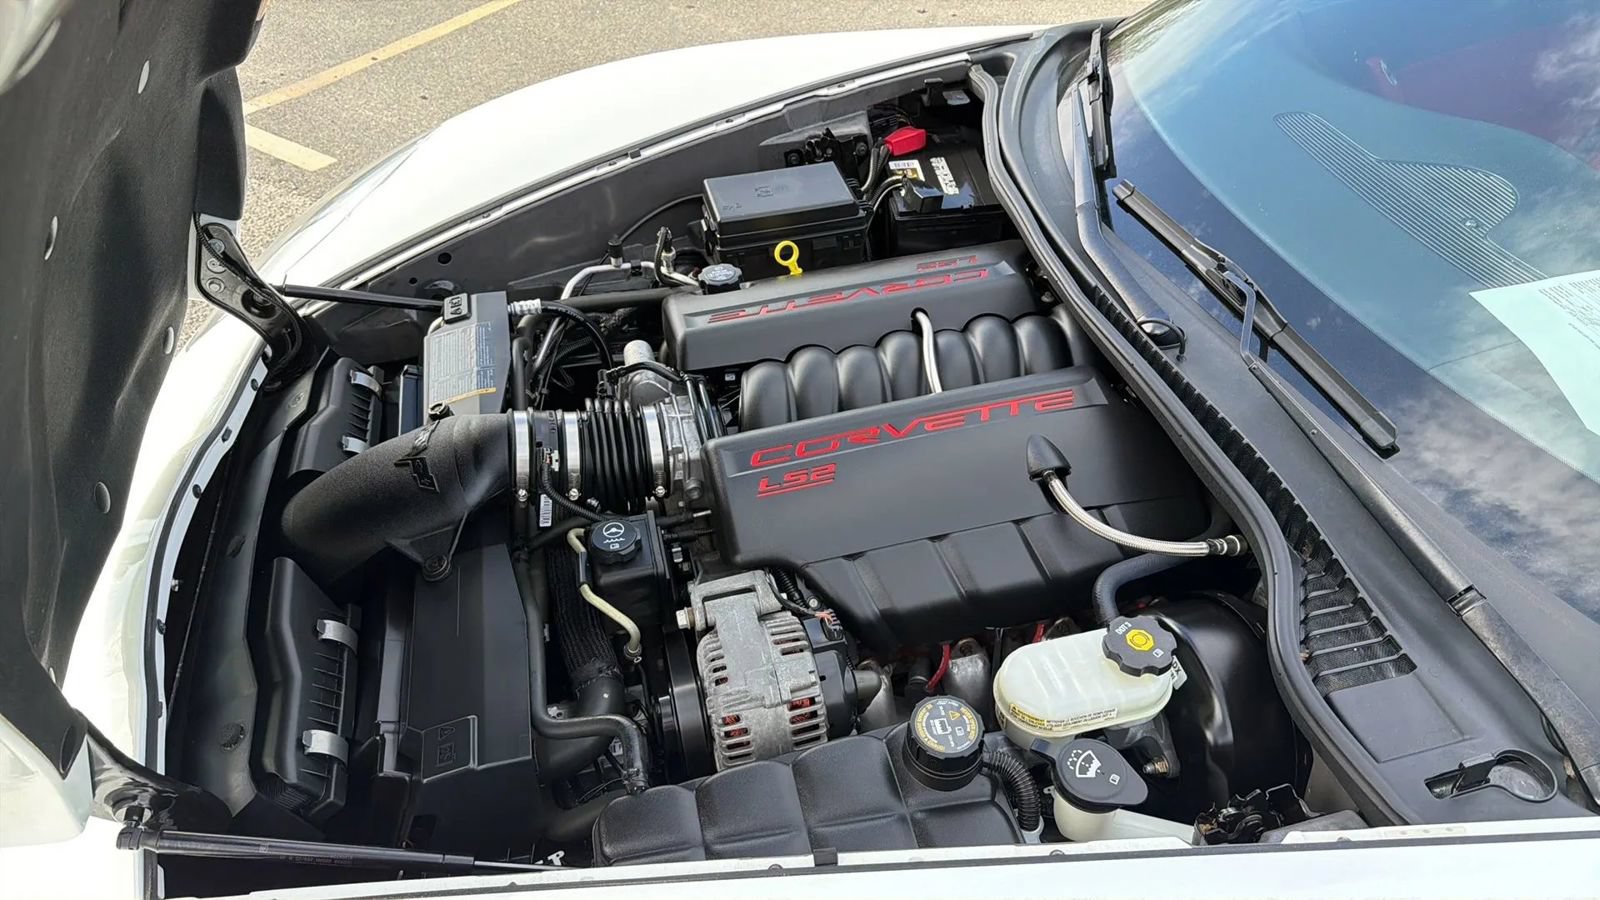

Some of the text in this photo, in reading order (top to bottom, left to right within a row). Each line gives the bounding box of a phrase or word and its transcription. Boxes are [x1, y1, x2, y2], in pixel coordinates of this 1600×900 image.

[708, 269, 989, 325] CORVETTE
[750, 389, 1075, 468] CORVETTE
[757, 462, 837, 498] LS2
[1115, 622, 1128, 635] DOT
